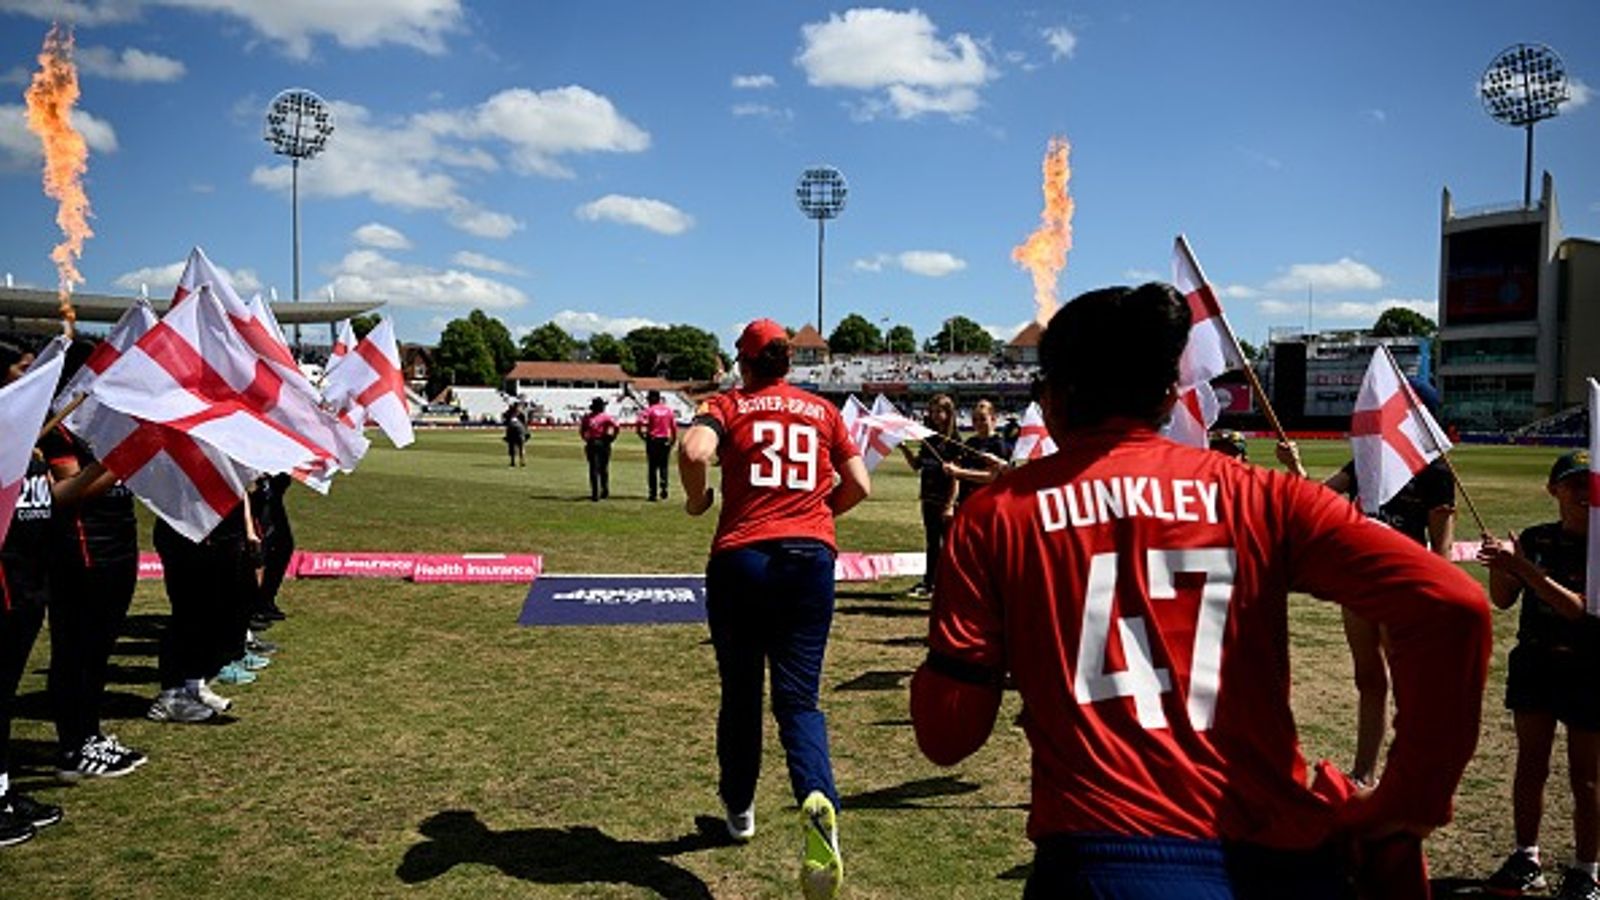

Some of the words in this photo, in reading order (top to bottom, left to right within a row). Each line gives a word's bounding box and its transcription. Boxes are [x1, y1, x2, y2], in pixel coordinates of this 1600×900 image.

[750, 421, 817, 491] 39
[1037, 476, 1218, 532] DUNKLEY
[314, 557, 342, 570] Life
[414, 562, 463, 576] Health
[1075, 547, 1237, 732] 47
